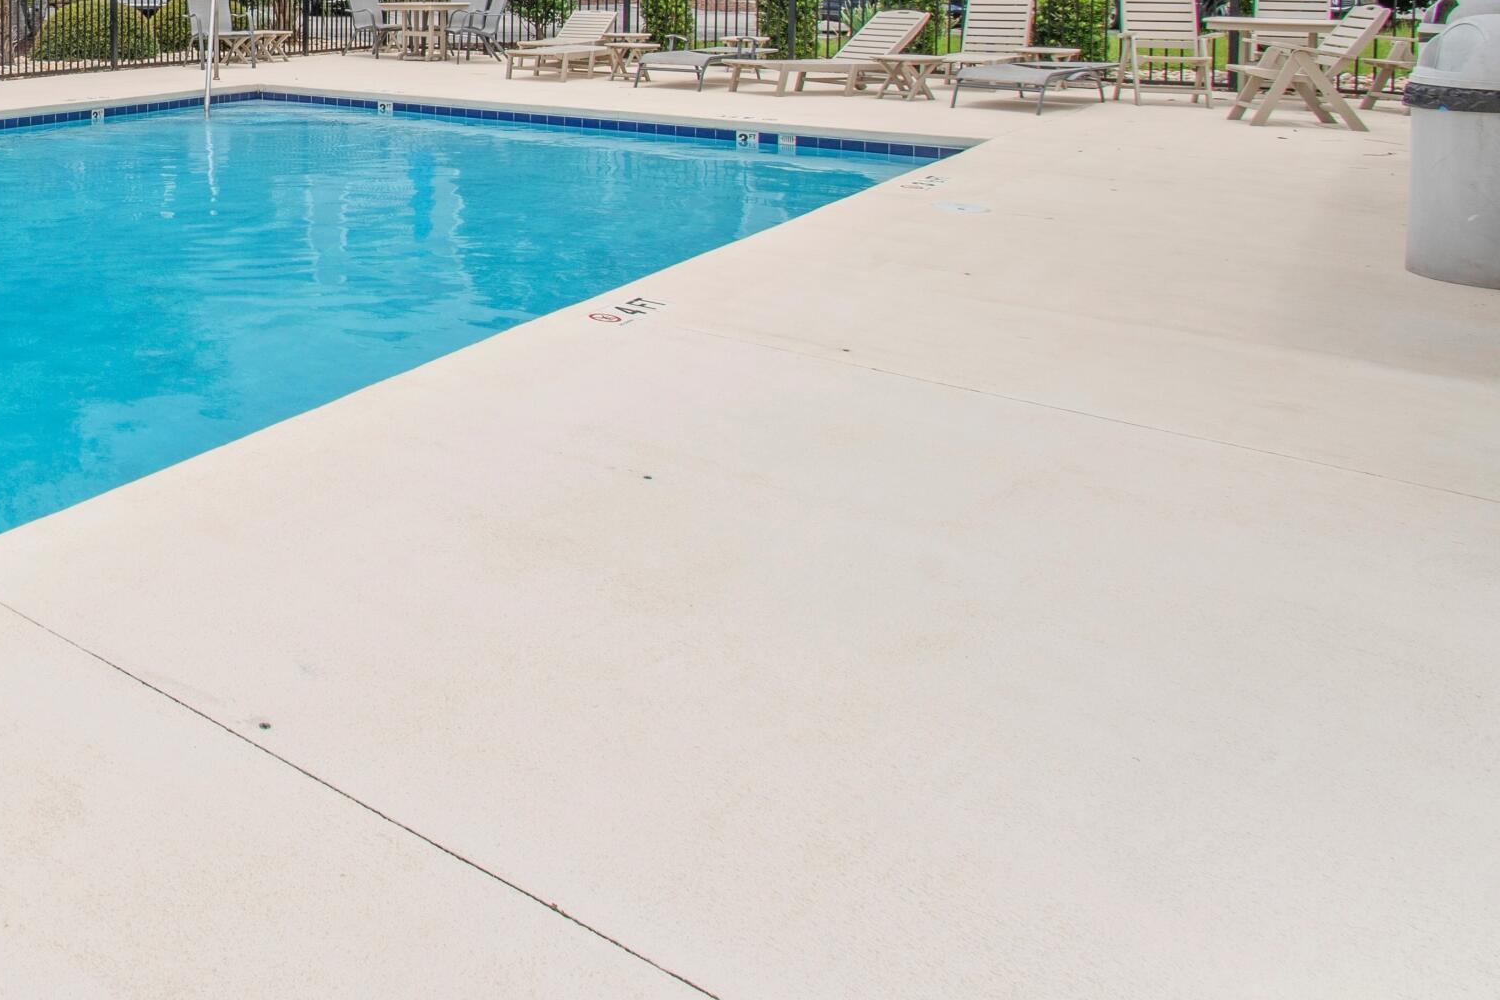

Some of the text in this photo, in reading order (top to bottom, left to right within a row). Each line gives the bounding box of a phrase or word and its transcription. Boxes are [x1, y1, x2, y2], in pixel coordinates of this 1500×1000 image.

[739, 133, 748, 142] 3
[614, 297, 666, 315] 4 FT
